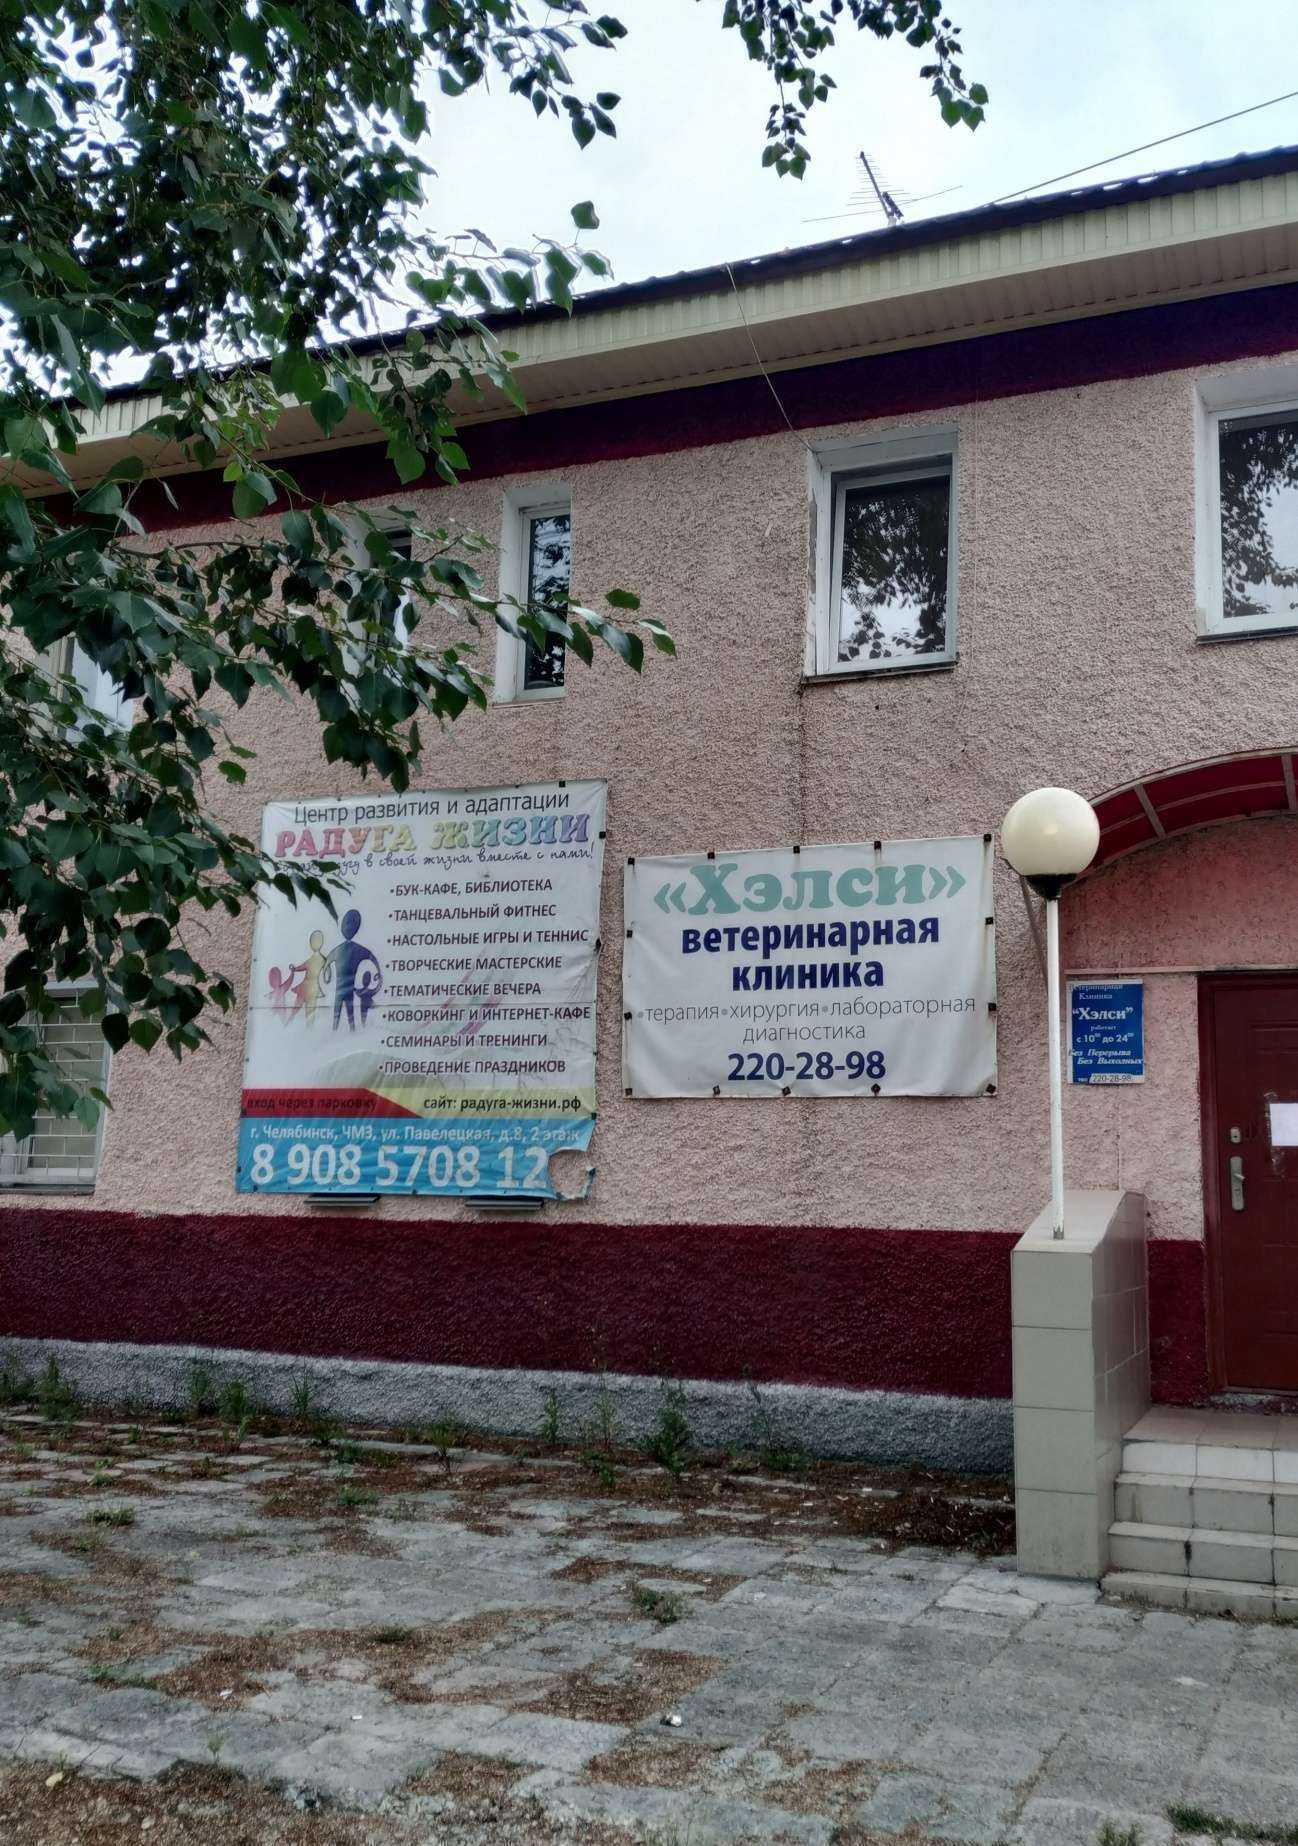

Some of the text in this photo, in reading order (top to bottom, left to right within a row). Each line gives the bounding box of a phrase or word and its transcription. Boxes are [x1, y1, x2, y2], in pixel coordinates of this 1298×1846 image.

[294, 793, 569, 826] Центр развития и адаптации
[275, 813, 592, 859] РАДУГА ЖИЗНИ
[366, 852, 373, 868] в
[423, 855, 473, 871] жизни
[478, 846, 532, 863] вместе
[536, 852, 545, 860] с
[551, 840, 594, 860] нами!
[395, 879, 553, 898] БУК-КАФЕ, БИБЛИОТЕКА
[653, 862, 967, 916] «Хэлси»
[393, 904, 557, 922] ТАНЦЕВАЛЬНЫЙ ФИТНЕС
[392, 928, 590, 947] НАСТОЛЬНЫЕ ИГРЫ И ТЕННИС
[682, 917, 940, 960] ветеринарная
[391, 955, 563, 972] ТВОРЧЕСКИЕ МАСТЕРСКИЕ
[732, 960, 885, 992] клиника
[389, 982, 542, 998] ТЕМАТИЧЕСКИЕ ВЕЧЕРА
[388, 1006, 591, 1023] КОВОРКИНГ И ИНТЕРНЕТ-КАФЕ
[385, 1033, 548, 1049] СЕМИНАРЫ И ТРЕНИНГИ
[742, 1023, 866, 1045] диагностика
[1102, 1036, 1115, 1044] до
[384, 1059, 567, 1076] ПРОВЕДЕНИЕ ПРАЗДНИКОВ
[728, 1050, 887, 1081] 220-28-98
[278, 1098, 314, 1111] через
[318, 1097, 377, 1112] парковку
[424, 1095, 581, 1112] сайт: радуга-жизни.рф
[250, 1124, 580, 1143] г. Челябинск, ЧМЗ, ул. Павелецкая, д.8, 2 этаж
[252, 1144, 275, 1185] 8
[287, 1145, 360, 1187] 908
[375, 1146, 480, 1188] 5708
